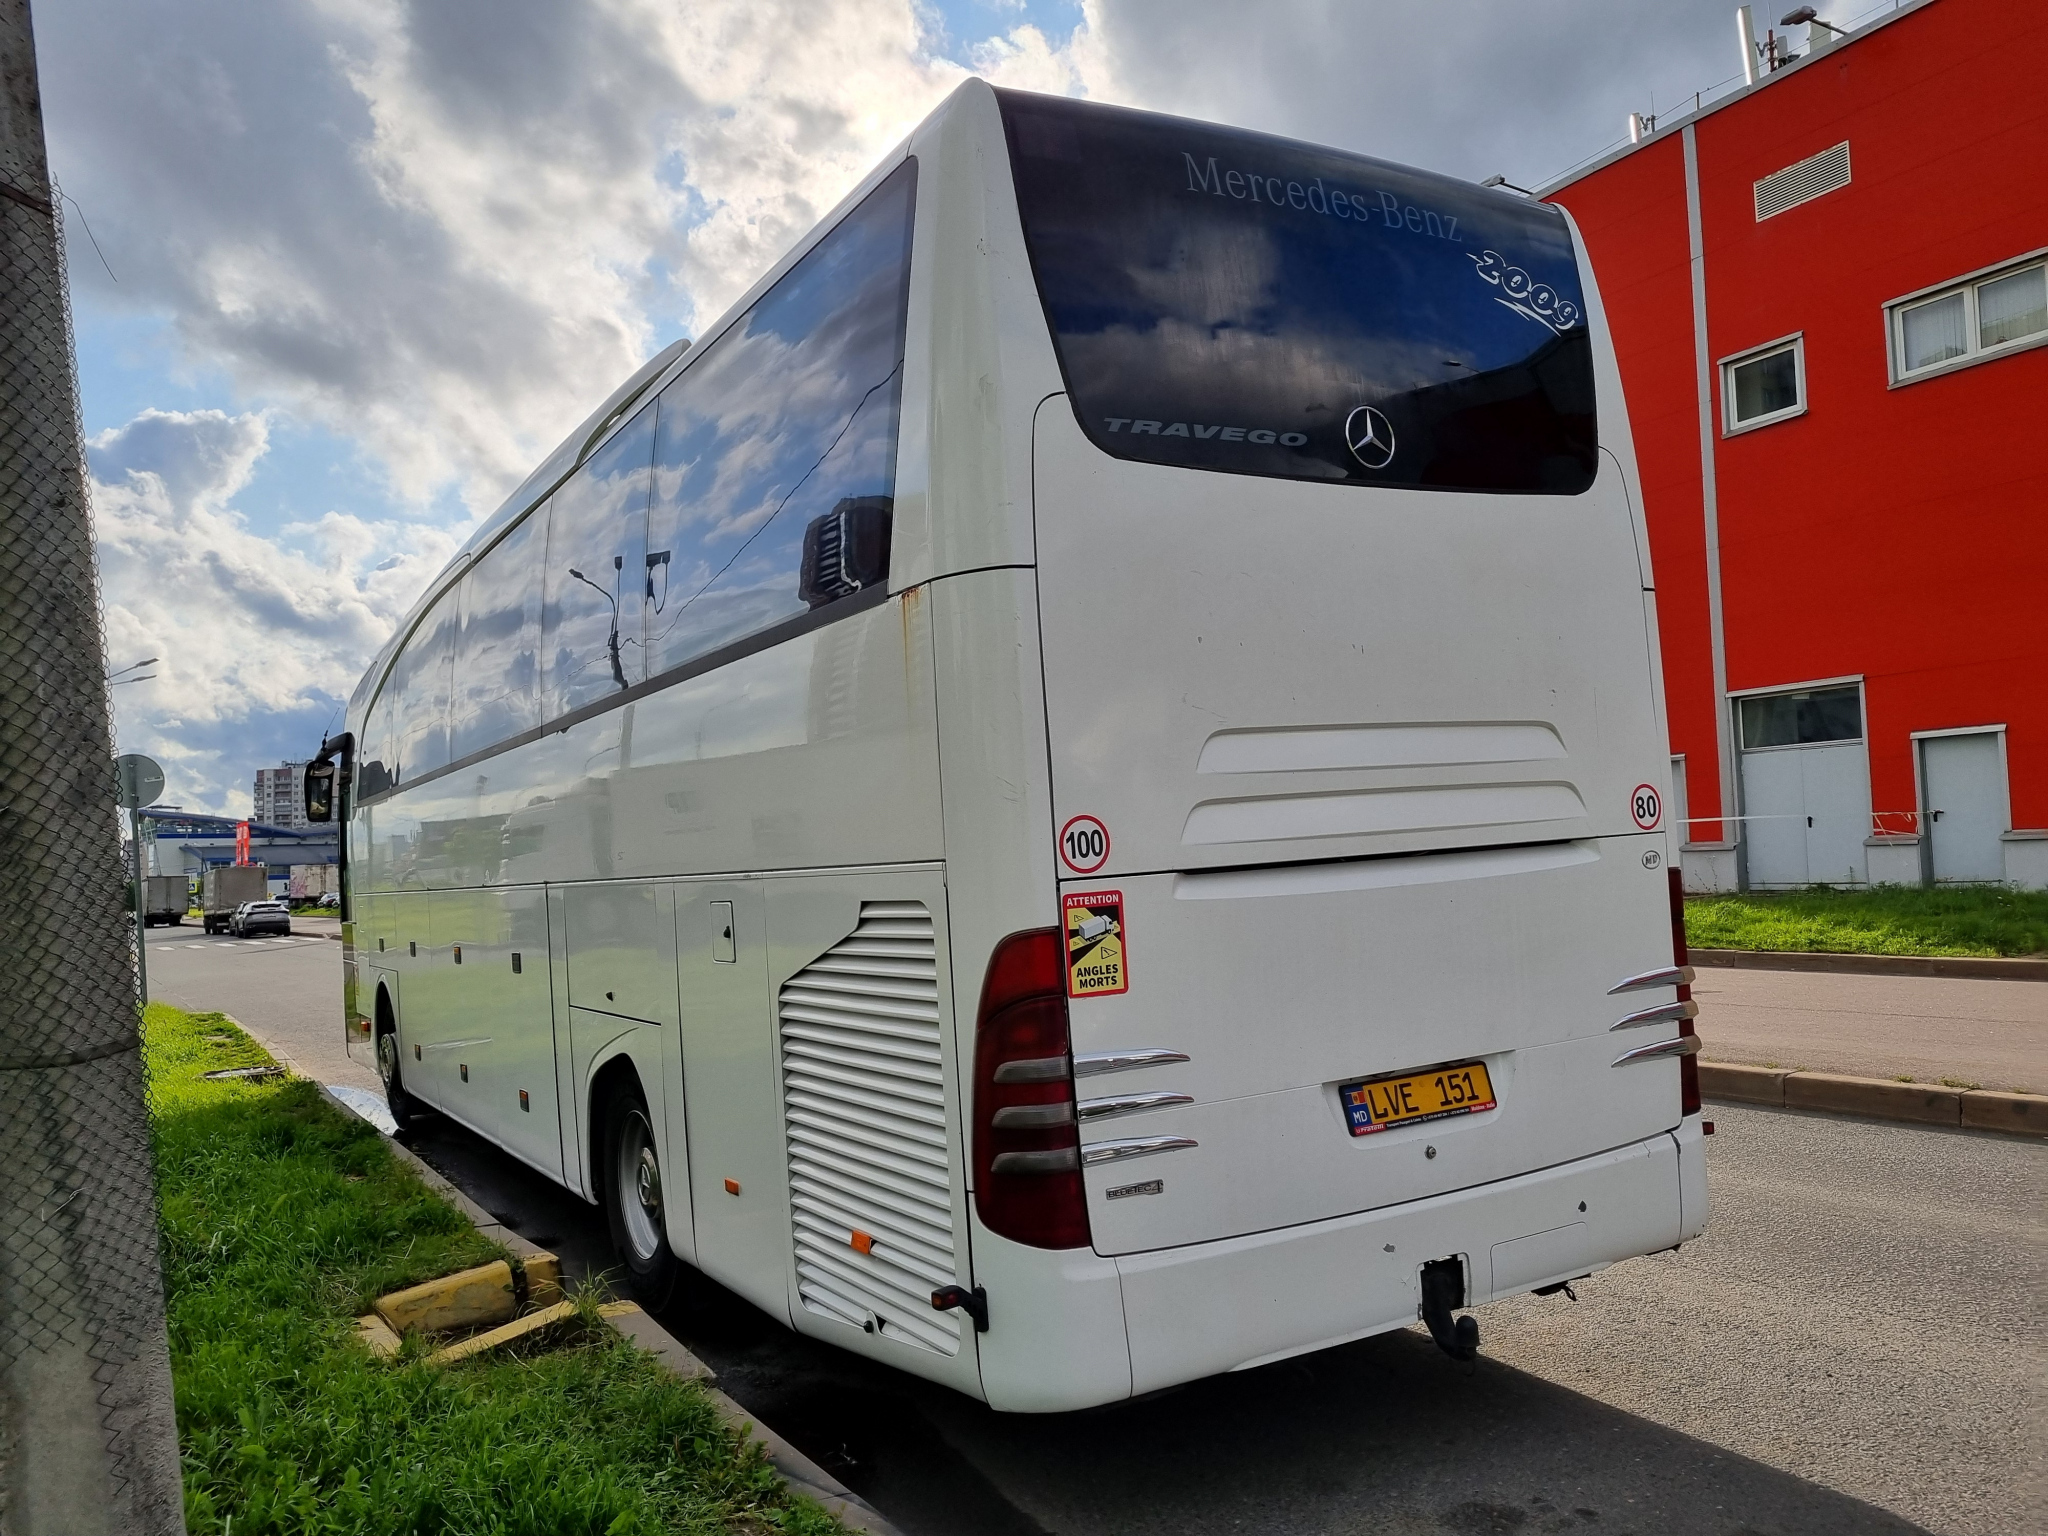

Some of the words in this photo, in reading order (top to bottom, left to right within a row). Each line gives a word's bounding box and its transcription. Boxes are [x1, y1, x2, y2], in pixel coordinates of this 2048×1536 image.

[1181, 151, 1463, 243] Mercedes-Benz
[1467, 249, 1580, 331] 2009
[1103, 417, 1309, 447] TRAVEGO
[1635, 795, 1657, 819] 80
[1065, 829, 1104, 859] 100
[1066, 893, 1119, 907] ATTENTION
[1076, 963, 1119, 978] ANGLES
[1079, 975, 1118, 989] MORTS
[1366, 1082, 1420, 1120] LVE
[1434, 1071, 1480, 1107] 151
[1353, 1110, 1368, 1124] MD
